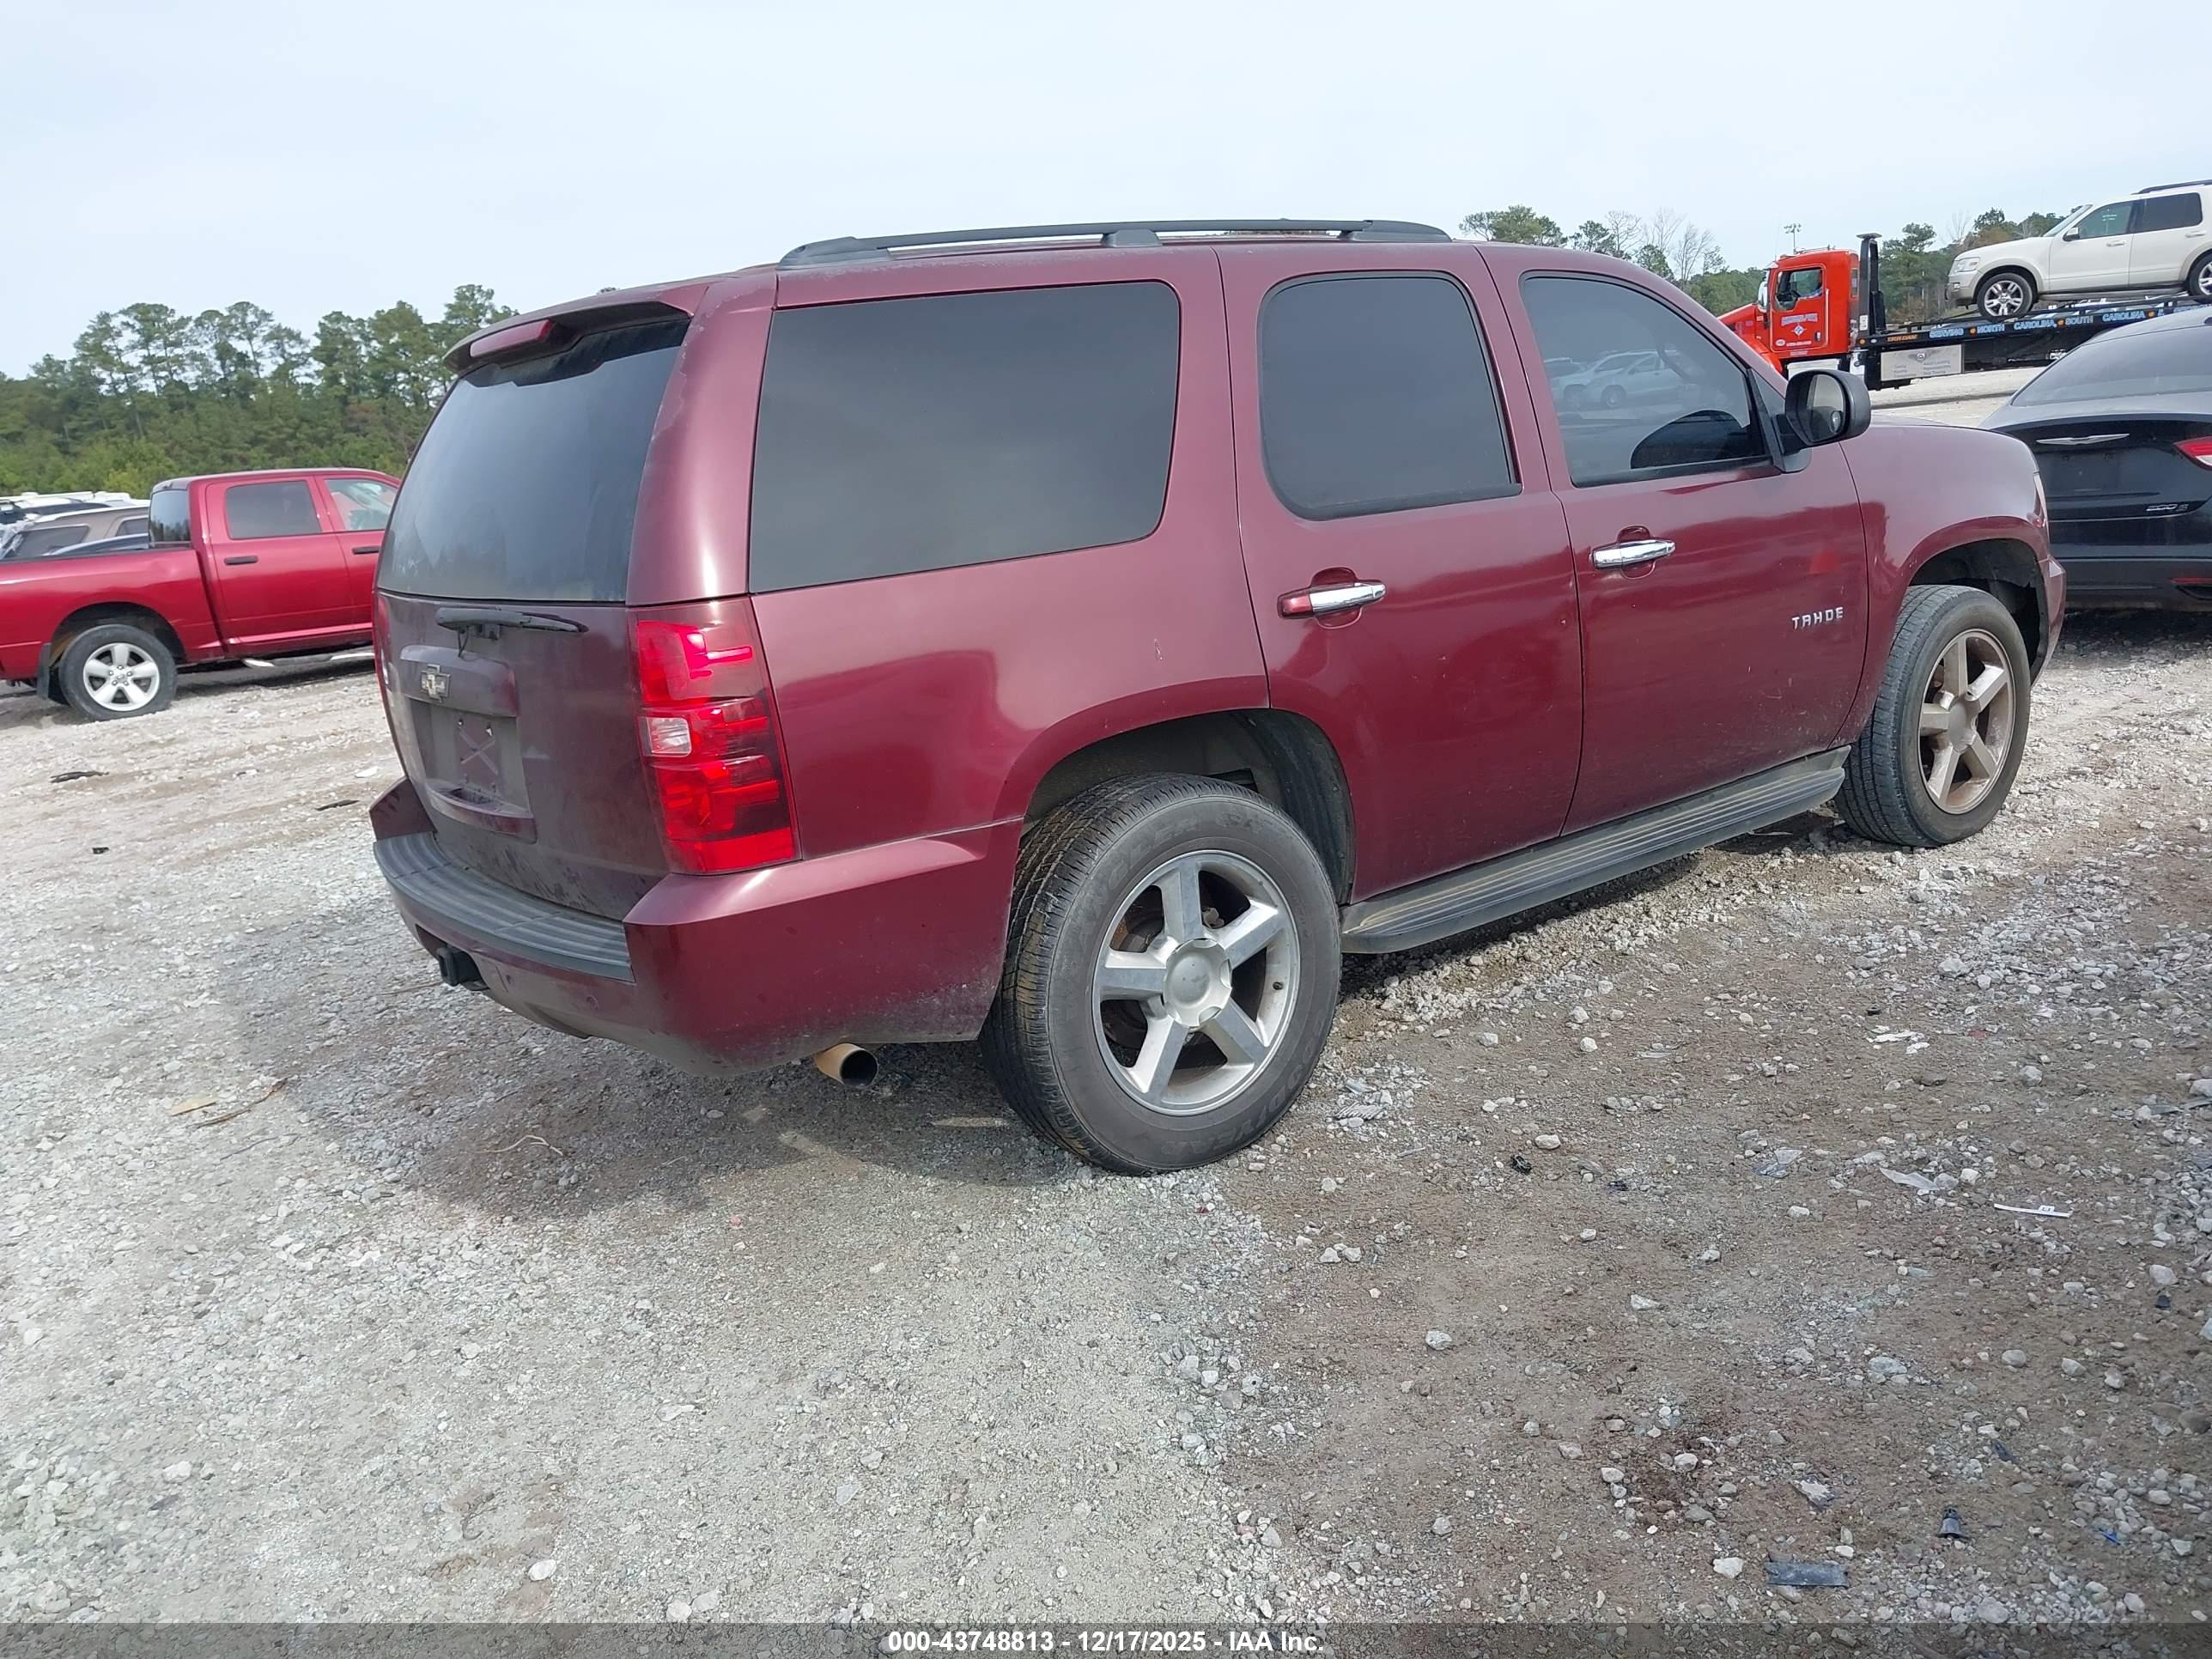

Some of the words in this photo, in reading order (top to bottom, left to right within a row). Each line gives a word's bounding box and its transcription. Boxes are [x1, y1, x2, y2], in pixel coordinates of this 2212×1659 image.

[1977, 324, 2006, 334] NORTH
[2065, 315, 2094, 325] SOUTH
[2102, 310, 2146, 322] CAROLINA
[1791, 606, 1844, 629] TAHOE
